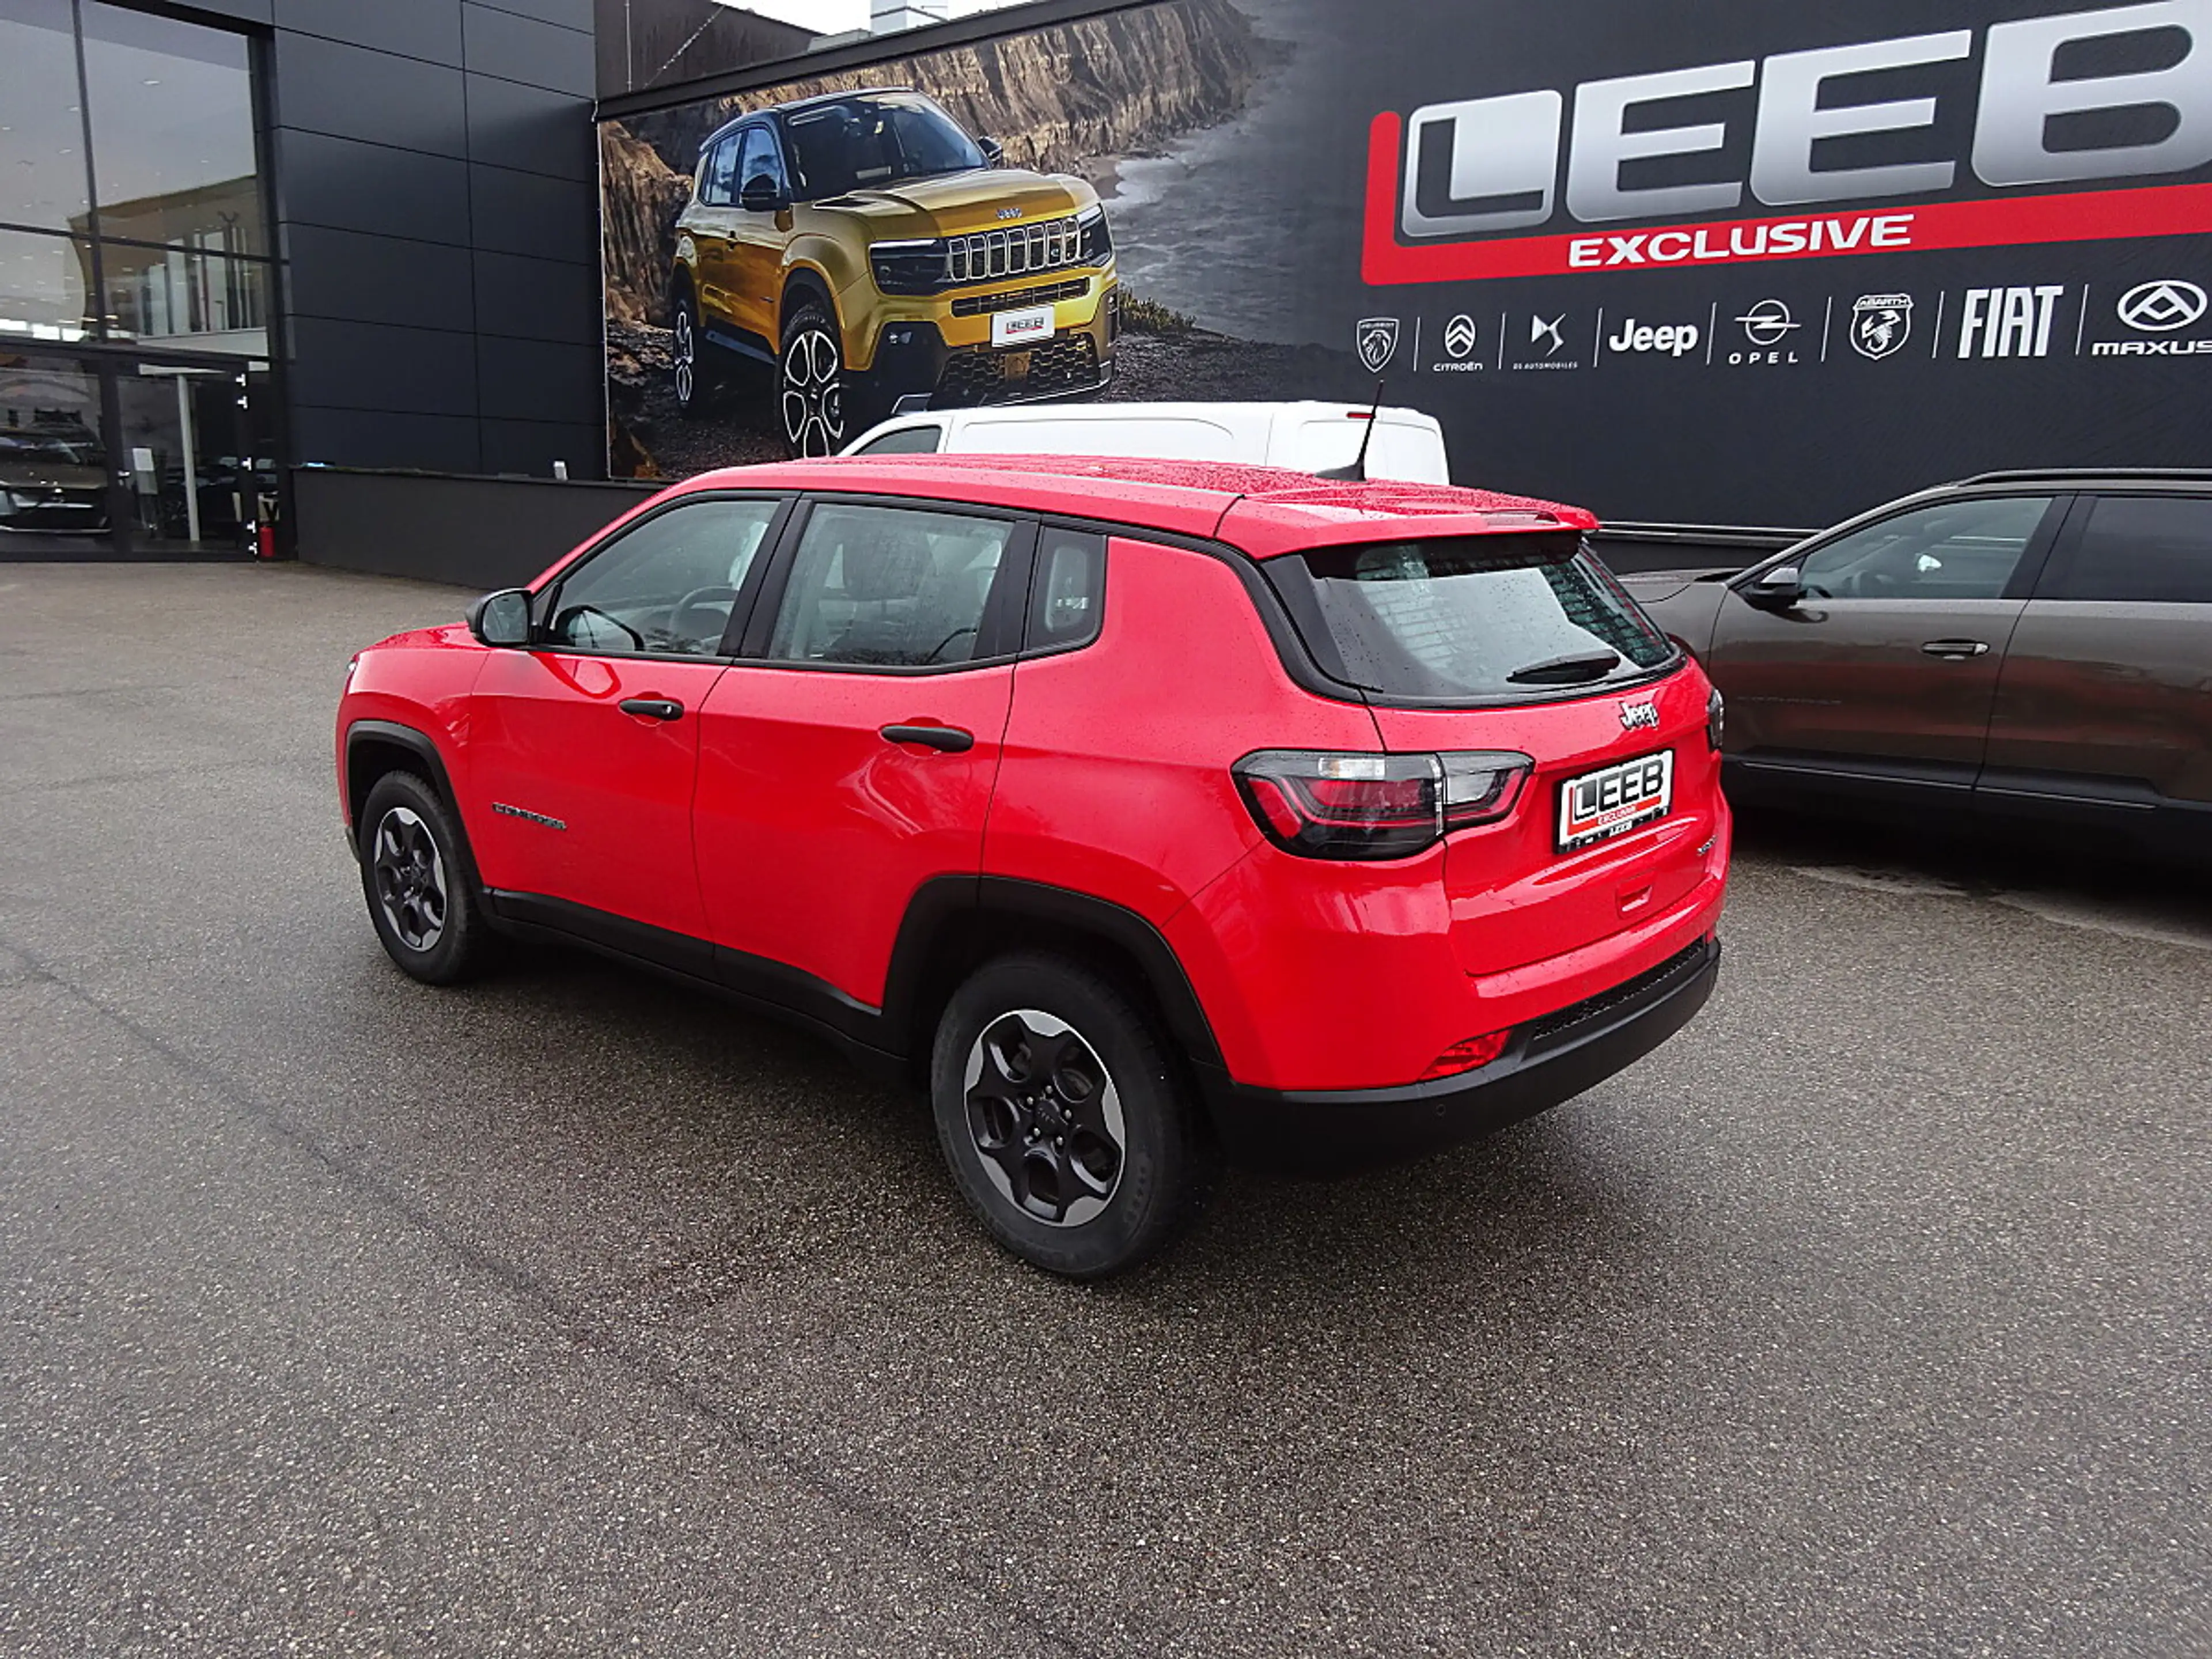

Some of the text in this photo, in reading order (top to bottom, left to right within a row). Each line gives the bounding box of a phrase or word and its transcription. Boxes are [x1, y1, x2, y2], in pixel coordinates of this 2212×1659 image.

[1402, 0, 2212, 237] LEEB
[1568, 214, 1915, 267] EXCLUSIVE
[1609, 319, 1699, 357] Jeep
[1958, 286, 2064, 358] FIAT
[1729, 351, 1798, 364] OPEL
[2092, 340, 2212, 355] MAXUS
[1619, 702, 1658, 729] Jeep
[1574, 759, 1664, 821] LEEB
